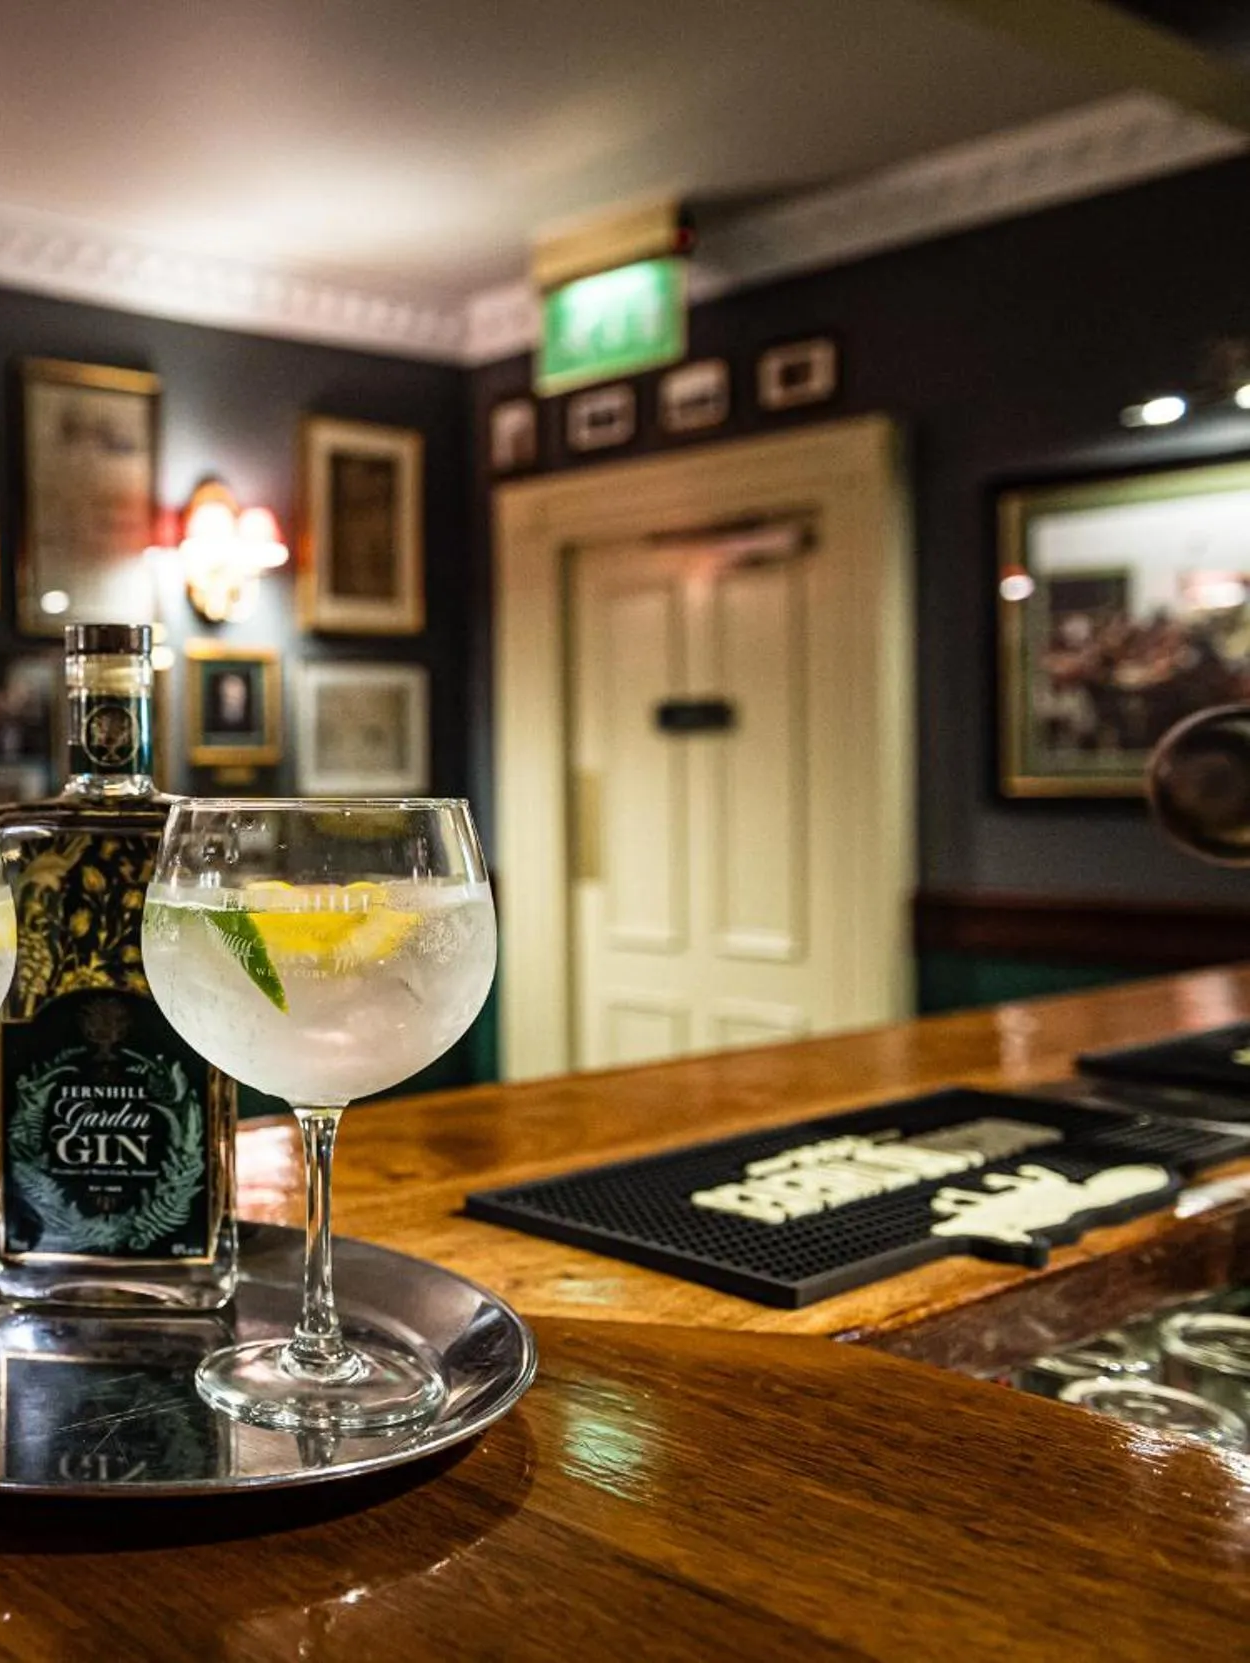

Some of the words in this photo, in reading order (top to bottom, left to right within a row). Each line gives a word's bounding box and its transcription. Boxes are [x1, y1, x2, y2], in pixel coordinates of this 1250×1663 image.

[255, 966, 288, 978] WET
[61, 1085, 148, 1099] FERNHILL
[52, 1102, 151, 1138] Garden
[56, 1134, 152, 1166] GIN
